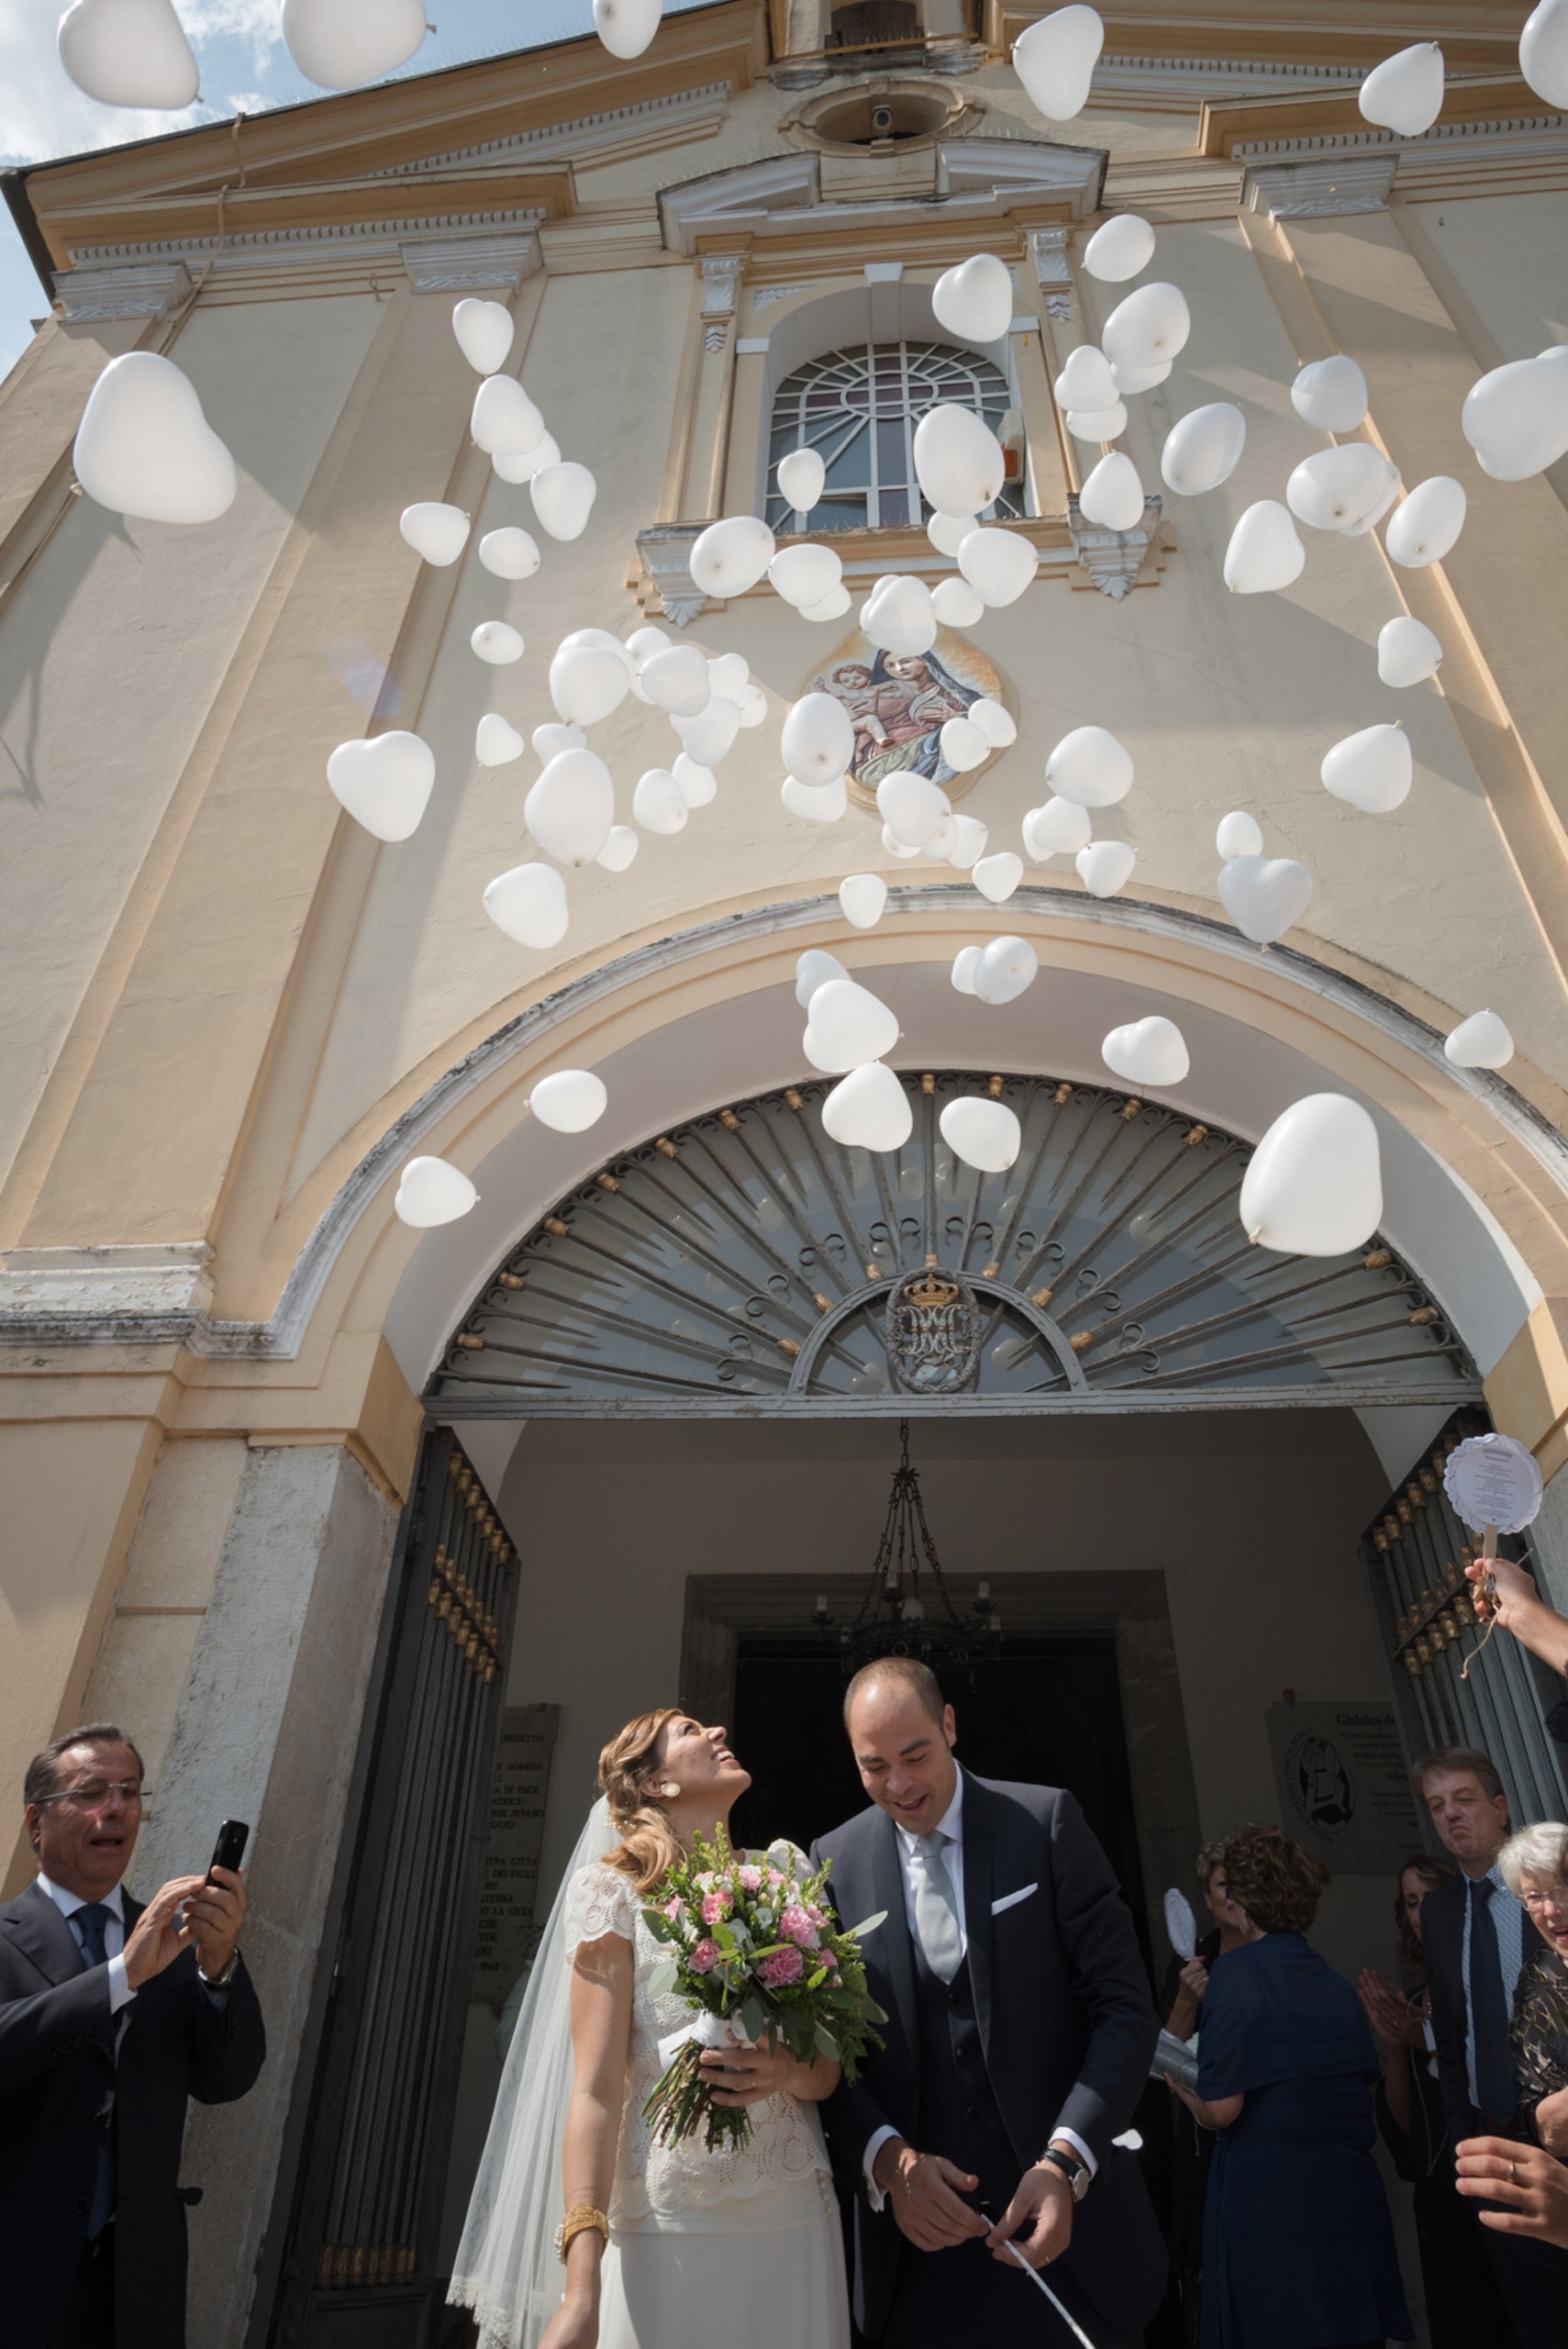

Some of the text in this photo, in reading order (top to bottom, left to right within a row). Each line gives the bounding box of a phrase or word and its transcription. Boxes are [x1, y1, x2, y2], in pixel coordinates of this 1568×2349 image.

[1336, 1713, 1382, 1726] Giubileo
[506, 1763, 542, 1771] SORRISI
[504, 1786, 514, 1794] DI
[517, 1786, 539, 1794] PACE
[511, 1809, 544, 1818] INVANO
[492, 1869, 506, 1878] DEI
[510, 1869, 535, 1878] FIGLI
[492, 1907, 505, 1916] LA
